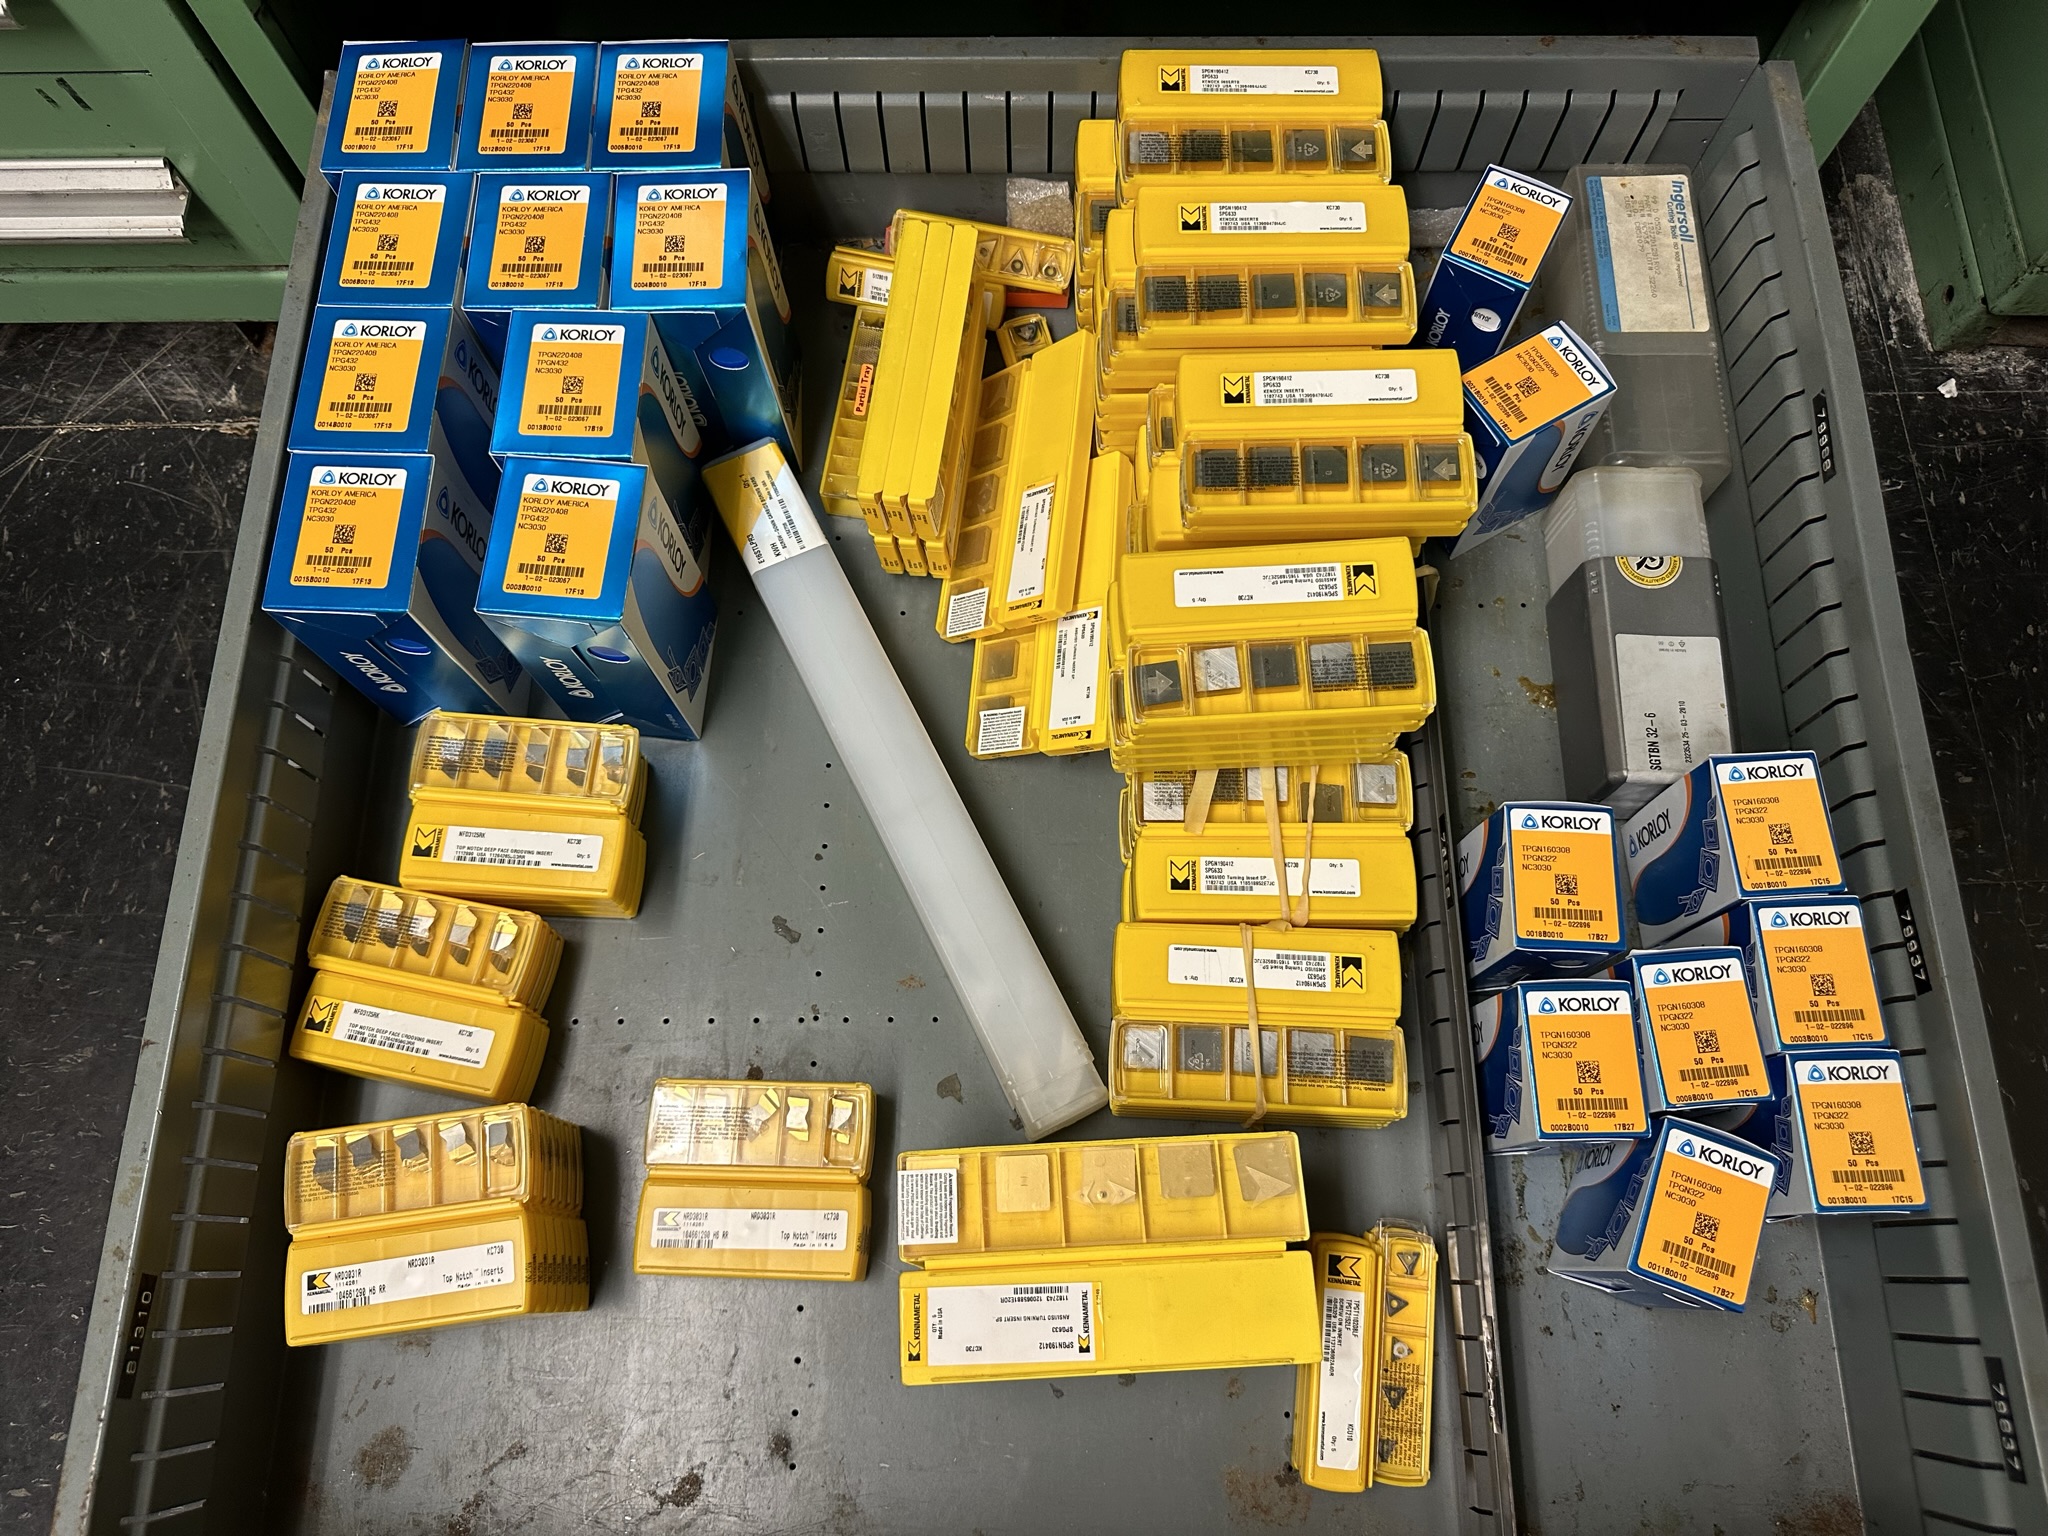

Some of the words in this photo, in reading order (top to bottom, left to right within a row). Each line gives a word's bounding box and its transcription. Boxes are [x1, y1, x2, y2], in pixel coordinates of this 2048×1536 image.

[382, 57, 433, 68] KORLOY
[515, 60, 568, 71] KORLOY
[642, 58, 695, 69] KORLOY
[382, 188, 437, 200] KORLOY
[526, 189, 581, 202] KORLOY
[664, 188, 718, 200] KORLOY
[1510, 182, 1561, 208] KORLOY
[1479, 207, 1504, 220] NC3030
[1667, 202, 1676, 224] Cutting
[1672, 180, 1694, 243] Ingersoll
[1669, 225, 1677, 240] Tools
[360, 325, 417, 337] KORLOY
[1426, 307, 1452, 347] KORLOY
[560, 329, 616, 341] KORLOY
[1515, 353, 1534, 373] NC3030
[1560, 346, 1601, 387] KORLOY
[856, 384, 868, 413] Partial
[862, 364, 873, 383] Tray
[660, 363, 687, 437] KORLOY
[1498, 418, 1512, 434] 17B27
[338, 472, 397, 486] KORLOY
[551, 481, 610, 496] KORLOY
[523, 497, 555, 505] KORLOY
[557, 500, 589, 508] AMERICA
[521, 514, 549, 522] TPG432
[518, 523, 546, 531] NC3030
[658, 512, 687, 579] KORLOY
[770, 542, 782, 558] KWH
[340, 651, 396, 685] KORLOY
[540, 656, 585, 692] KORLOY
[1646, 740, 1662, 771] SGTBN
[1746, 764, 1804, 779] KORLOY
[1733, 797, 1779, 806] TPGN160308
[1735, 806, 1768, 815] TPGN322
[1541, 816, 1601, 831] KORLOY
[1736, 816, 1765, 824] NC3030
[1636, 808, 1671, 848] KORLOY
[433, 828, 443, 858] KENNAMETAL
[1522, 845, 1570, 854] TPGN160308
[1768, 848, 1778, 856] 50
[1567, 899, 1580, 907] Pcs
[1790, 911, 1850, 926] KORLOY
[1588, 933, 1608, 941] 17B27
[1774, 945, 1823, 954] TPGN160308
[1900, 910, 1927, 981] 79937
[1776, 955, 1811, 963] TPGN322
[1672, 964, 1732, 982] KORLOY
[1777, 965, 1806, 973] NC3030
[1558, 997, 1620, 1012] KORLOY
[1656, 1001, 1706, 1012] TPGN160308
[1809, 1000, 1819, 1008] 50
[1826, 999, 1840, 1007] Pcs
[325, 1002, 339, 1034] KENNAMETAL
[1659, 1012, 1694, 1021] TPGN322
[1540, 1030, 1590, 1038] TPGN160308
[1660, 1022, 1690, 1031] NC3030
[1852, 1033, 1873, 1041] 17C15
[1828, 1065, 1889, 1080] KORLOY
[1737, 1089, 1758, 1097] 17C15
[1811, 1101, 1862, 1109] TPGN160308
[1613, 1122, 1635, 1131] 17B27
[1814, 1122, 1845, 1130] NC3030
[1584, 1145, 1615, 1171] KORLOY
[1699, 1145, 1764, 1179] KORLOY
[1668, 1180, 1705, 1200] TPGN322
[1670, 1170, 1722, 1195] TPGN160308
[1665, 1190, 1696, 1207] NC3030
[1891, 1195, 1913, 1203] 17C15
[781, 1231, 790, 1239] Top
[815, 1231, 837, 1240] Inserts
[1683, 1236, 1694, 1245] 50
[1701, 1242, 1715, 1254] Pcs
[442, 1273, 453, 1284] Top
[480, 1267, 504, 1276] Inserts
[1328, 1278, 1361, 1286] KENNAMETAL
[1647, 1261, 1687, 1282] 0011B0010
[1712, 1286, 1735, 1300] 17B27
[1082, 1290, 1090, 1334] KENNAMETAL
[126, 1291, 152, 1374] 81310
[1346, 1424, 1354, 1442] KCU10
